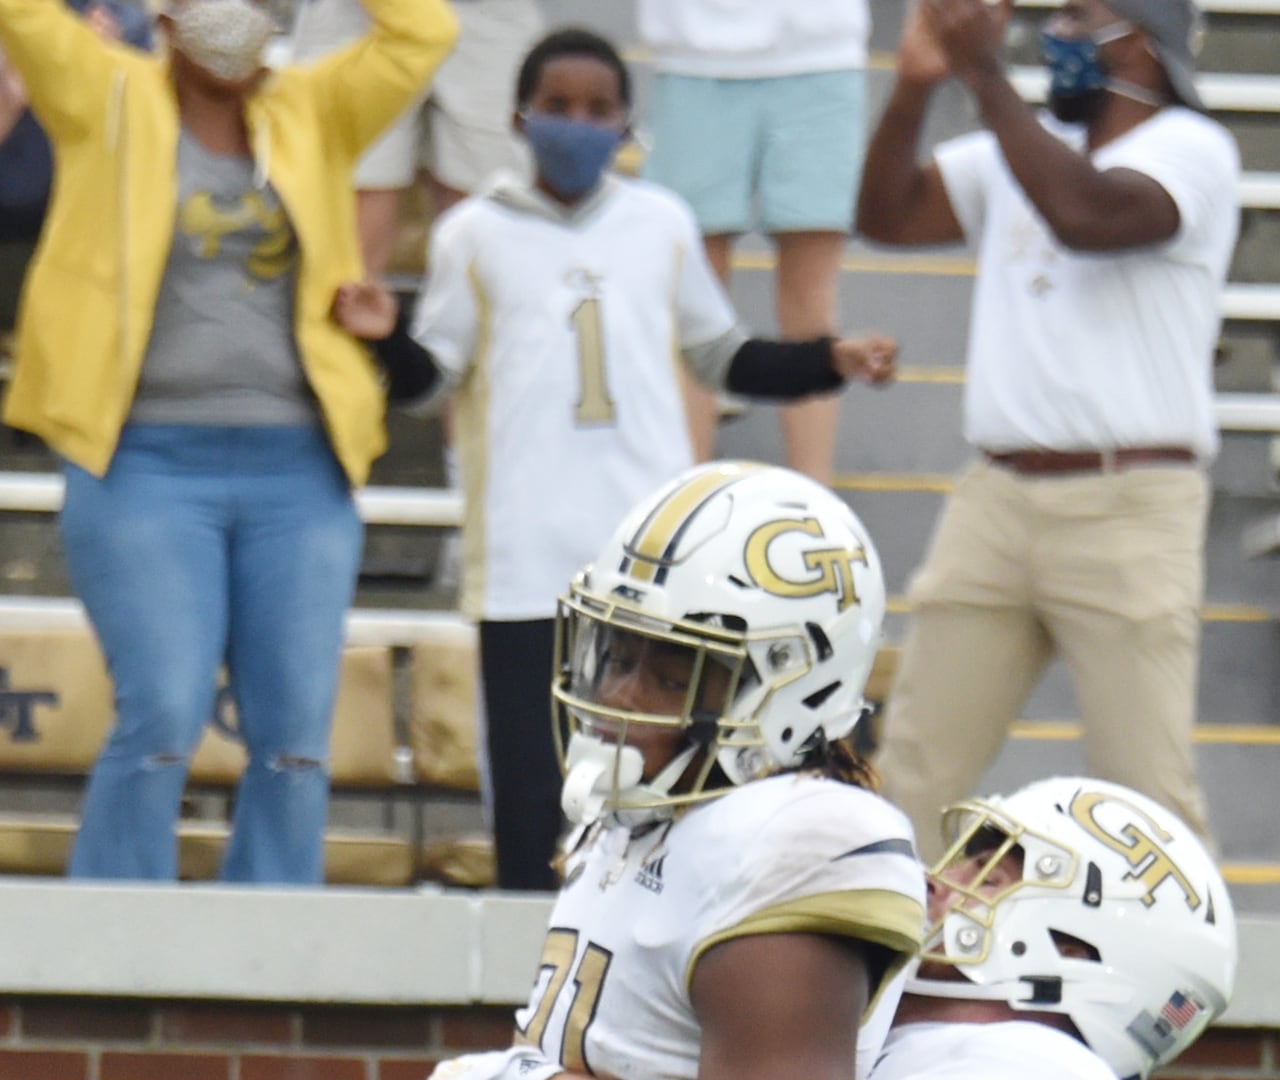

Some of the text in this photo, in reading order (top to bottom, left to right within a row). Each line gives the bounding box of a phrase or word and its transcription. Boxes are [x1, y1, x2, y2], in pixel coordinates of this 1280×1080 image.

[569, 297, 618, 427] 1
[744, 517, 868, 612] GT
[1069, 790, 1202, 912] GT
